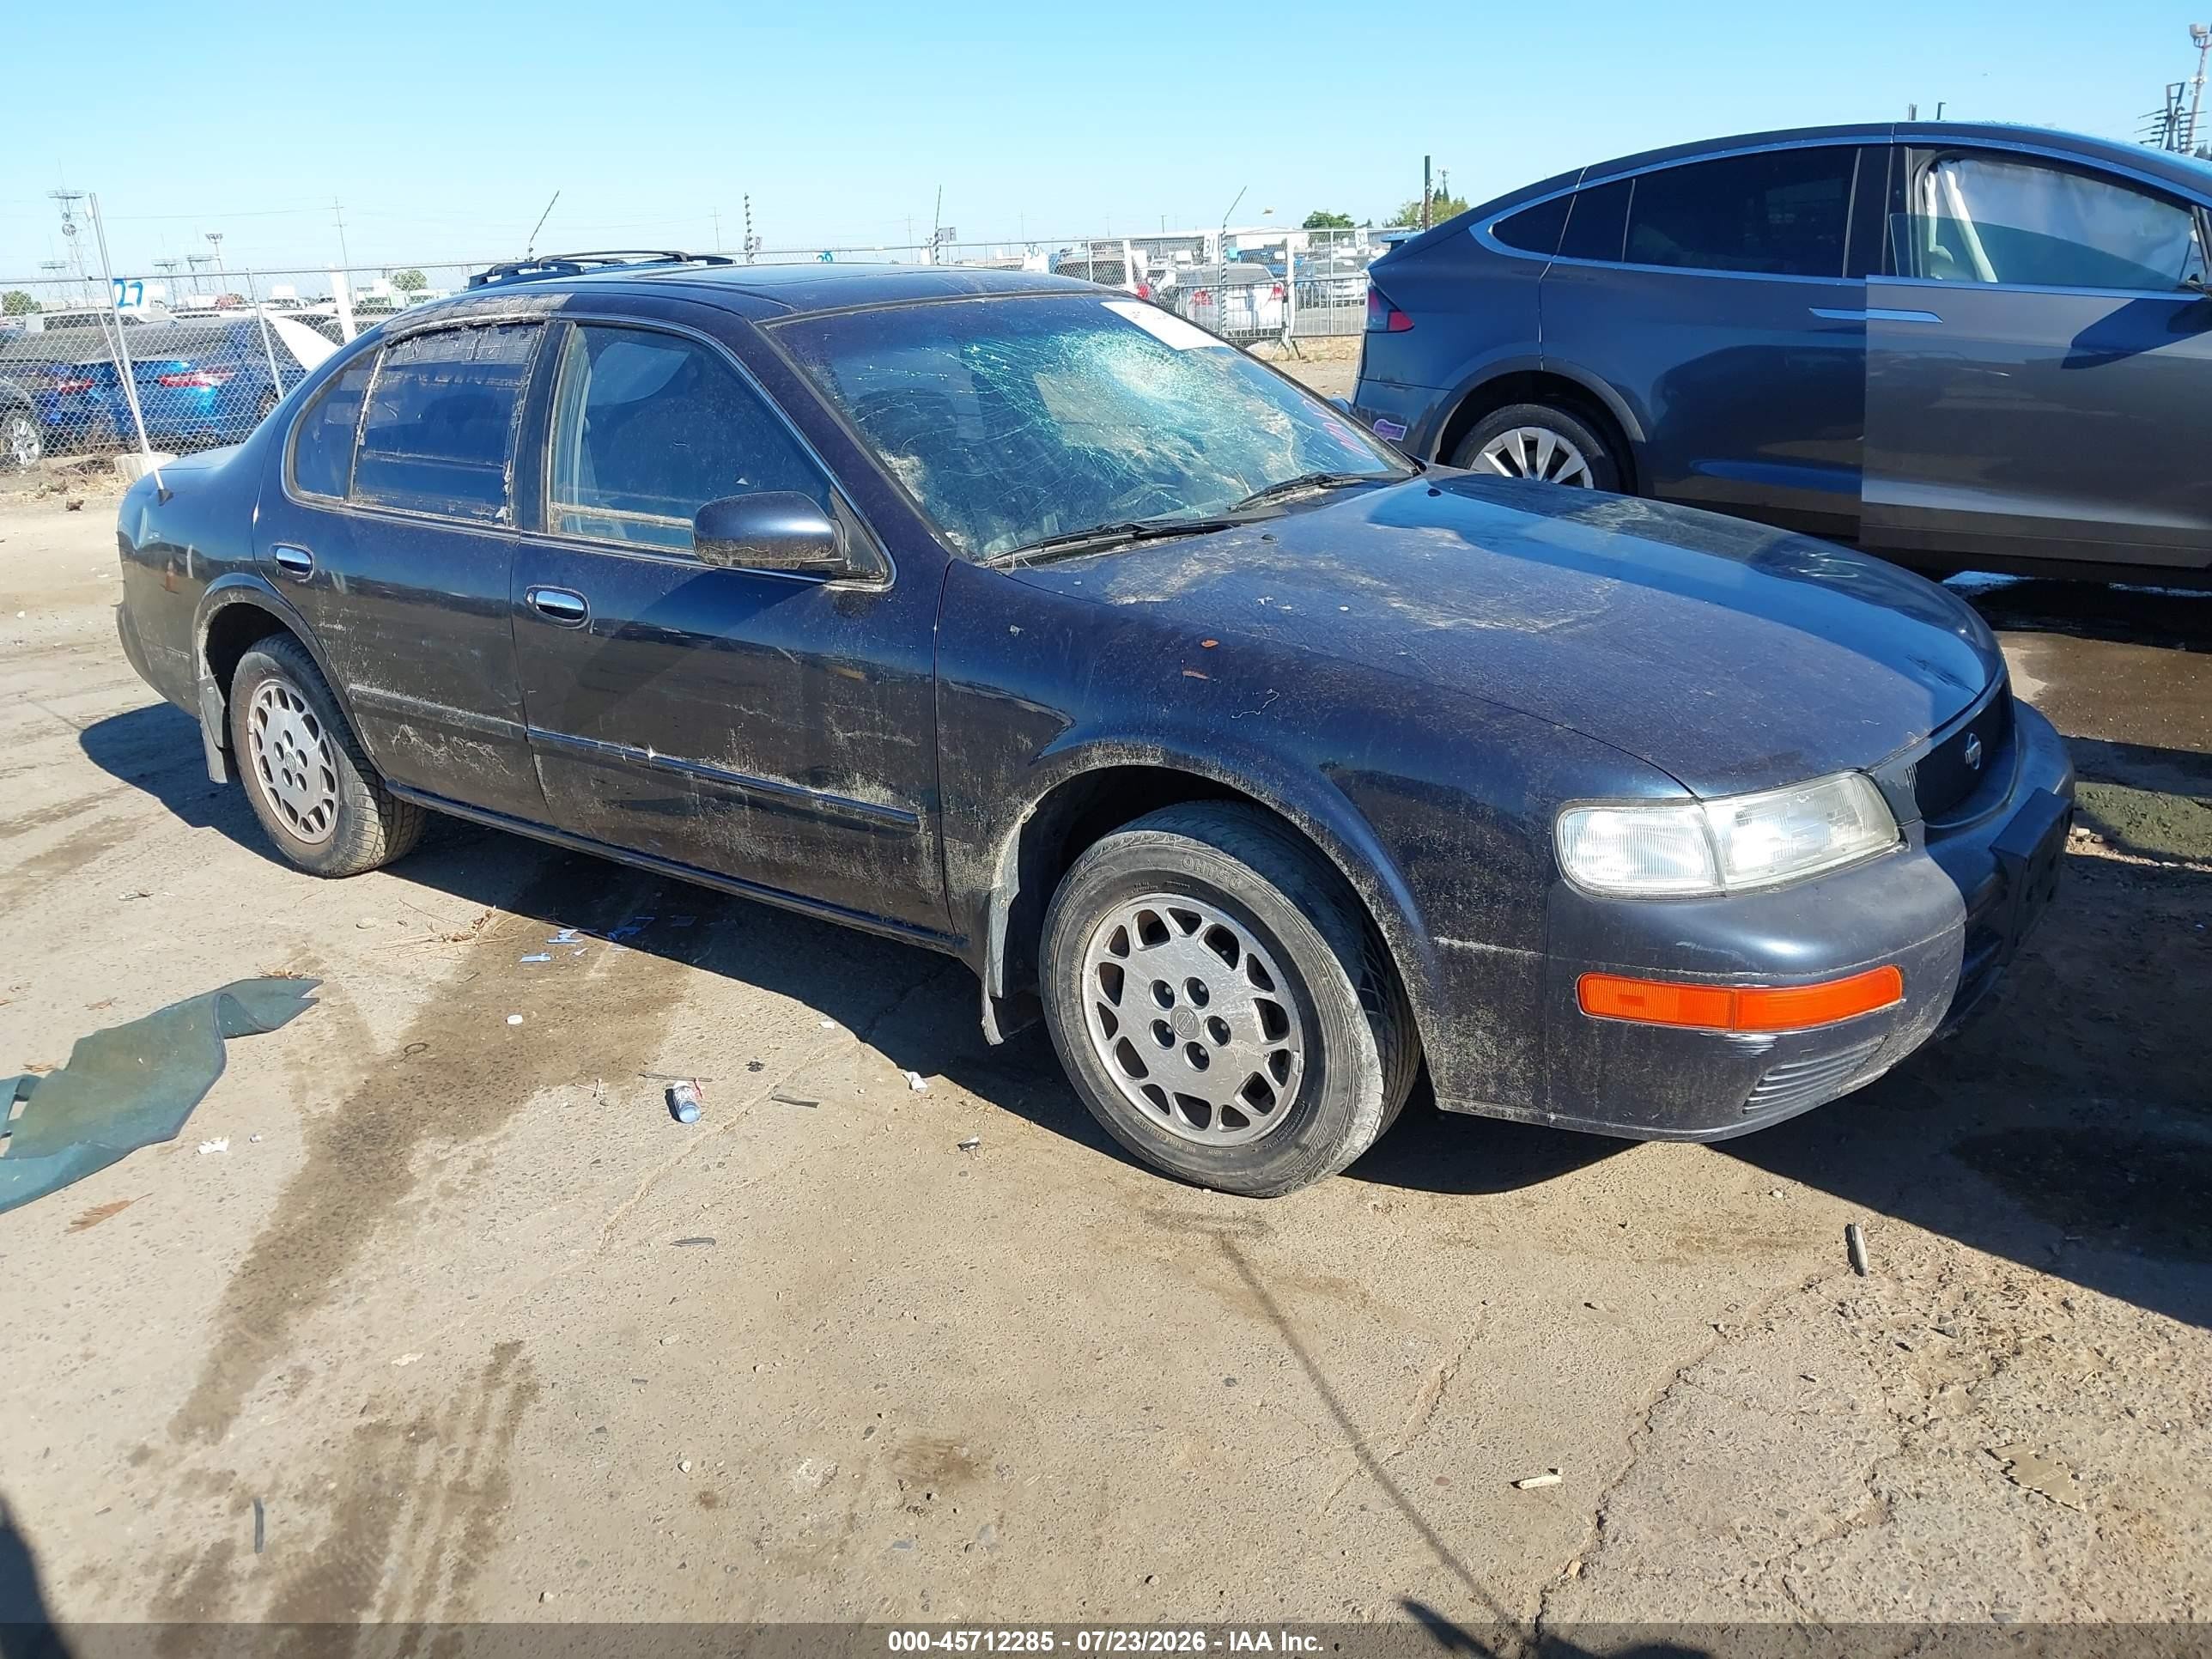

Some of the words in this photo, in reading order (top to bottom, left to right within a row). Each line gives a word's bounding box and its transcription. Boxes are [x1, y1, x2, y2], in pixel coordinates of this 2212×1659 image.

[1205, 239, 1216, 255] 31
[112, 277, 143, 308] 27
[1182, 855, 1243, 891] OHTSU
